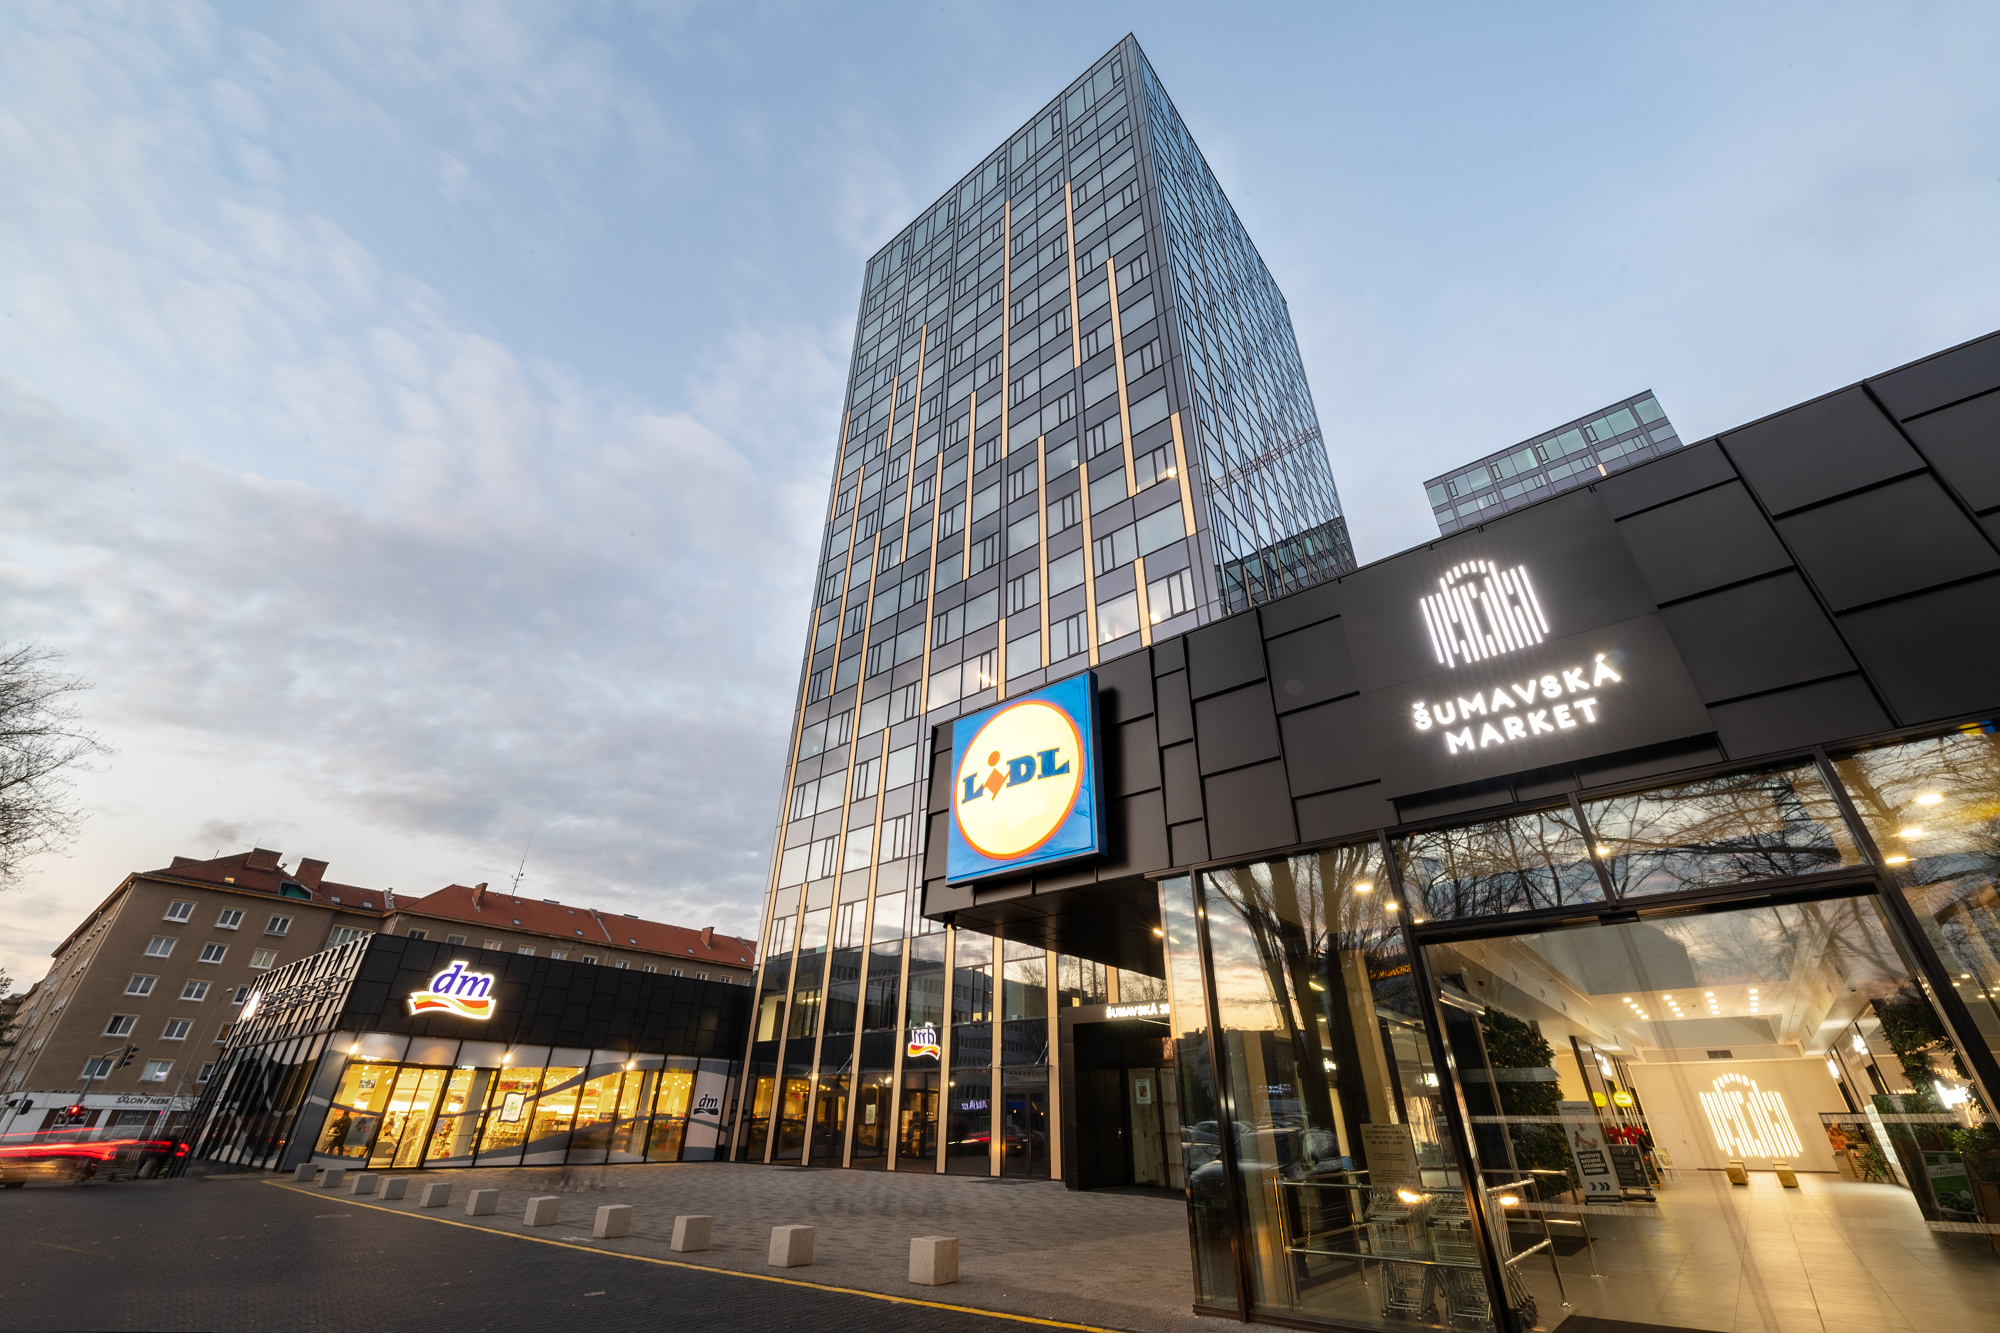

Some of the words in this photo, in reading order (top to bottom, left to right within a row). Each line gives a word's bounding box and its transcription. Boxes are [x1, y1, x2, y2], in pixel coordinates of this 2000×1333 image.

[1413, 653, 1621, 731] ŠUMAVSKÁ
[1445, 697, 1597, 754] MARKET
[432, 964, 491, 998] dm
[1106, 1003, 1158, 1018] ŠUMAVSKÁ
[698, 1093, 718, 1108] dm
